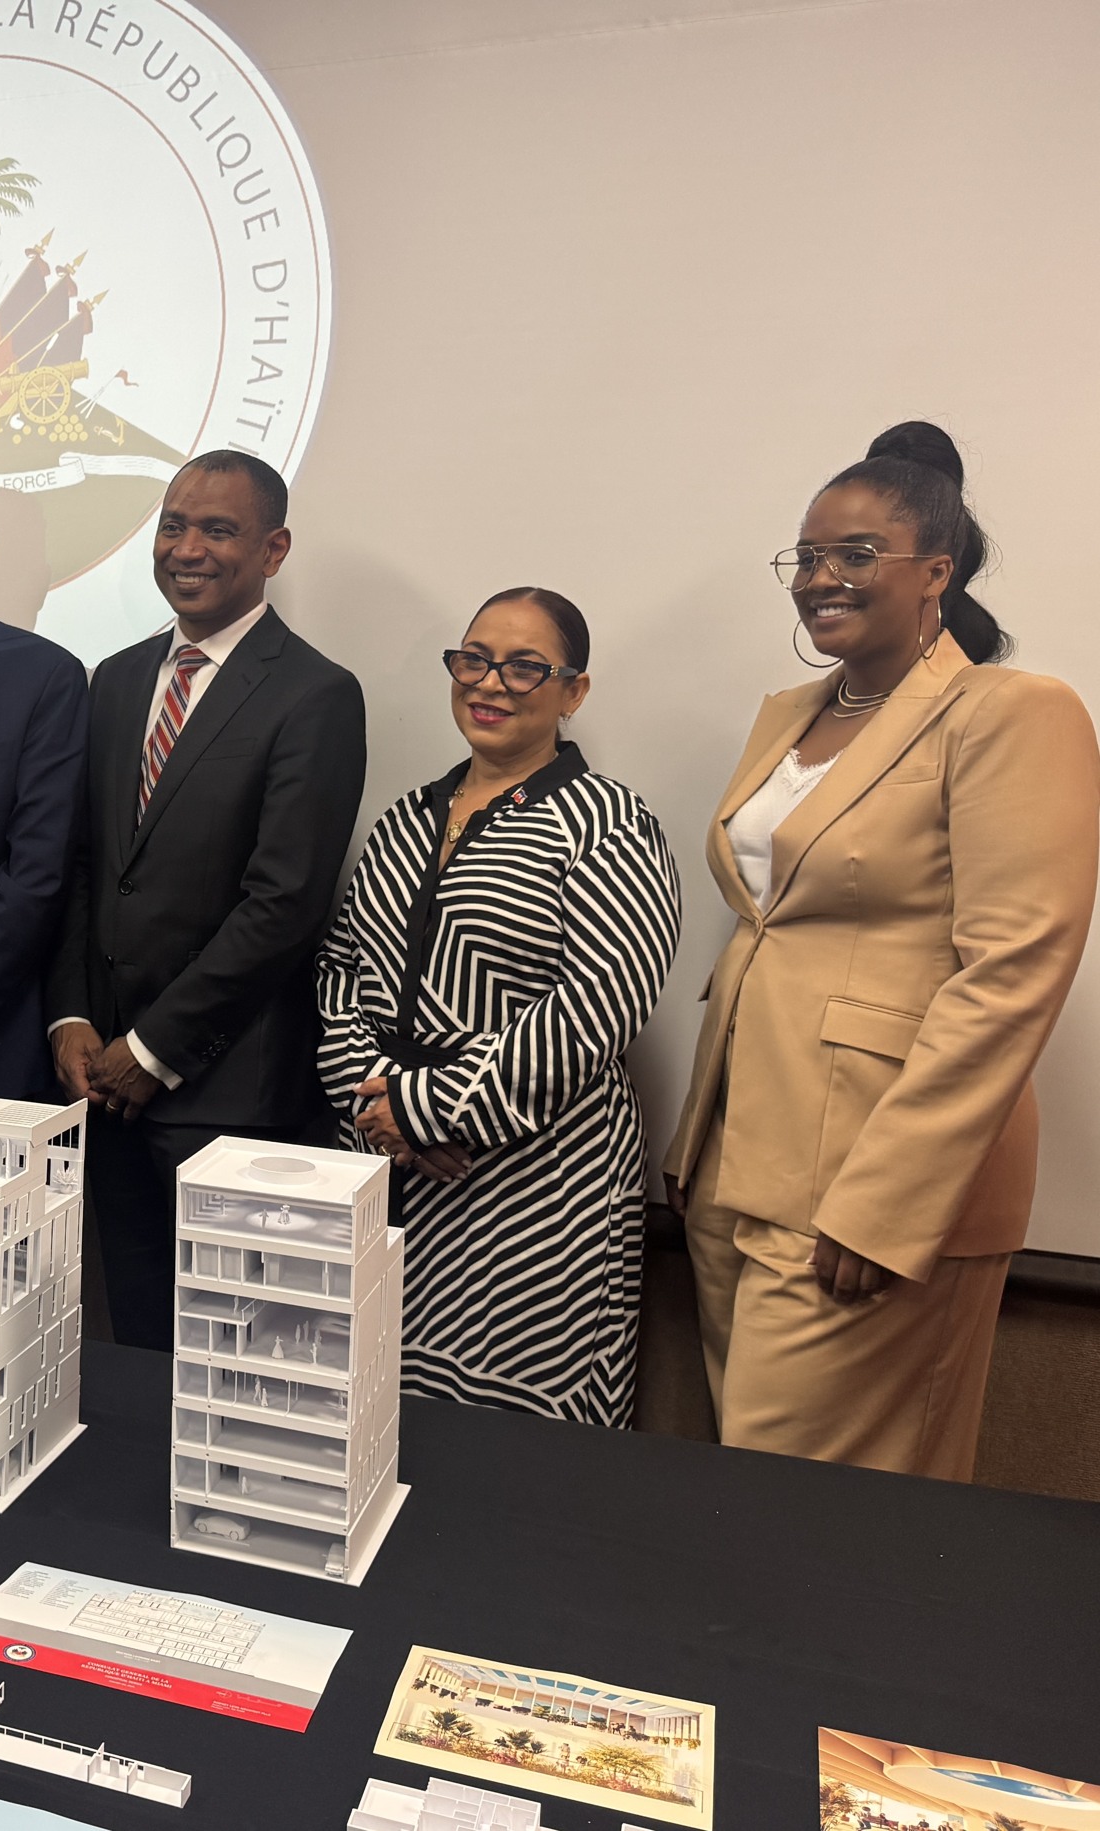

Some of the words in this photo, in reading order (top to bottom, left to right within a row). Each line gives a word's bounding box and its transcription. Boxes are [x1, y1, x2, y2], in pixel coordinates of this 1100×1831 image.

[54, 0, 280, 241] RÉPUBLIQUE
[227, 258, 290, 457] D'HAÏTI
[2, 470, 58, 490] FORCE
